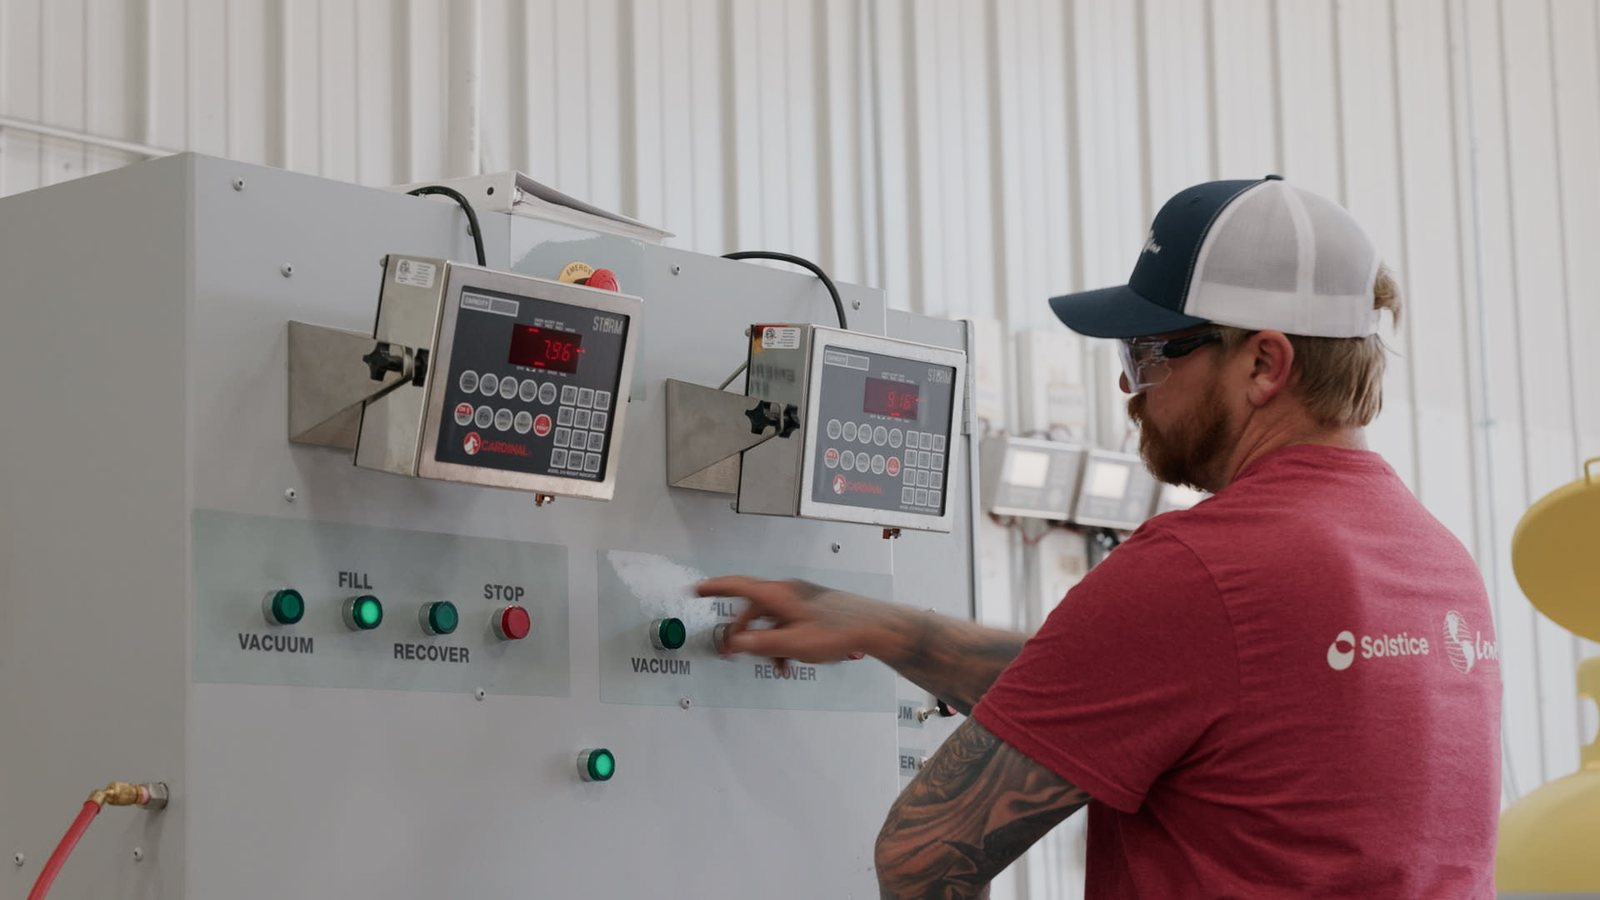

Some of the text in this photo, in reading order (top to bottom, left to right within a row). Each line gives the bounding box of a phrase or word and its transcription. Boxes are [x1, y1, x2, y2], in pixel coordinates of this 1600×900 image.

[593, 316, 624, 335] STORM
[480, 439, 529, 456] CARDINAL
[338, 571, 373, 590] FILL
[484, 584, 525, 601] STOP
[238, 633, 314, 654] VACUUM
[393, 643, 470, 663] RECOVER
[1361, 632, 1430, 659] Solstice
[631, 657, 690, 675] VACUUM
